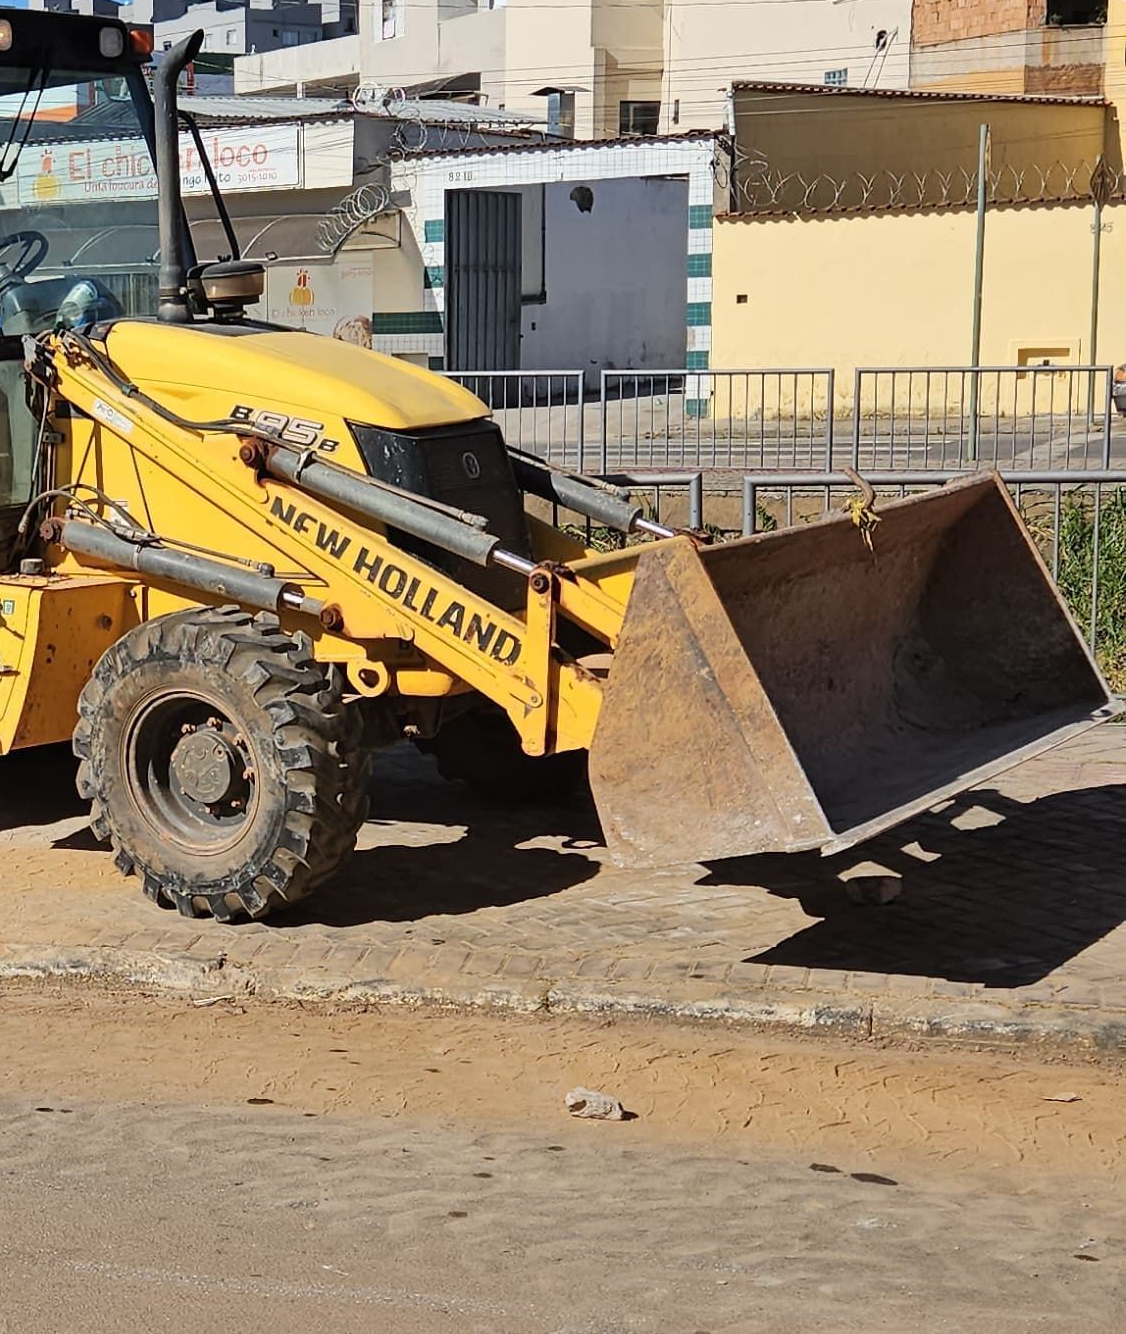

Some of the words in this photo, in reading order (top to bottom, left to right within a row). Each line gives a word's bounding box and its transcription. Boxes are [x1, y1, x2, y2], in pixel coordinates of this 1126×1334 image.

[69, 148, 91, 182] El
[212, 137, 269, 169] loco
[270, 495, 352, 561] NEW
[353, 546, 523, 666] HOLLAND
